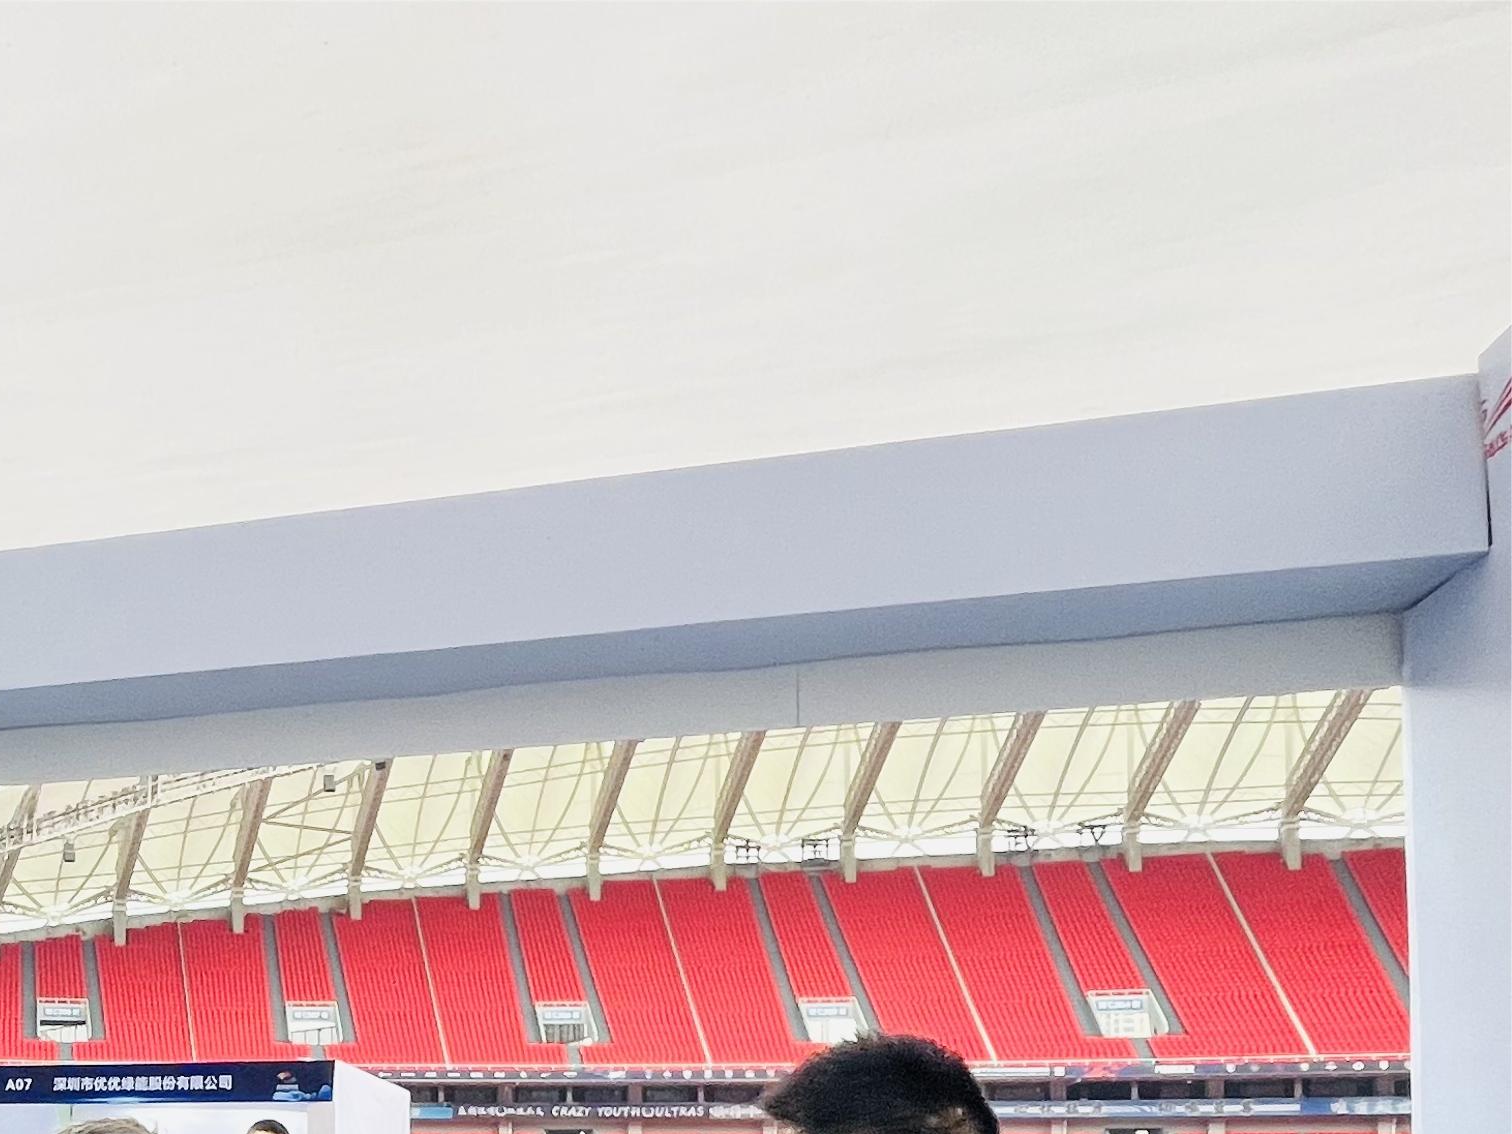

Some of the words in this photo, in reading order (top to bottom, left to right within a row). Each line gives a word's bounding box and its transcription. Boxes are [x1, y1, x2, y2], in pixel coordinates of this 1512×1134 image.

[5, 1078, 33, 1092] A07
[52, 1075, 233, 1093] 深圳市优优绿能股份有限公司
[551, 1105, 592, 1118] CRAZY
[597, 1105, 641, 1118] YOUTH
